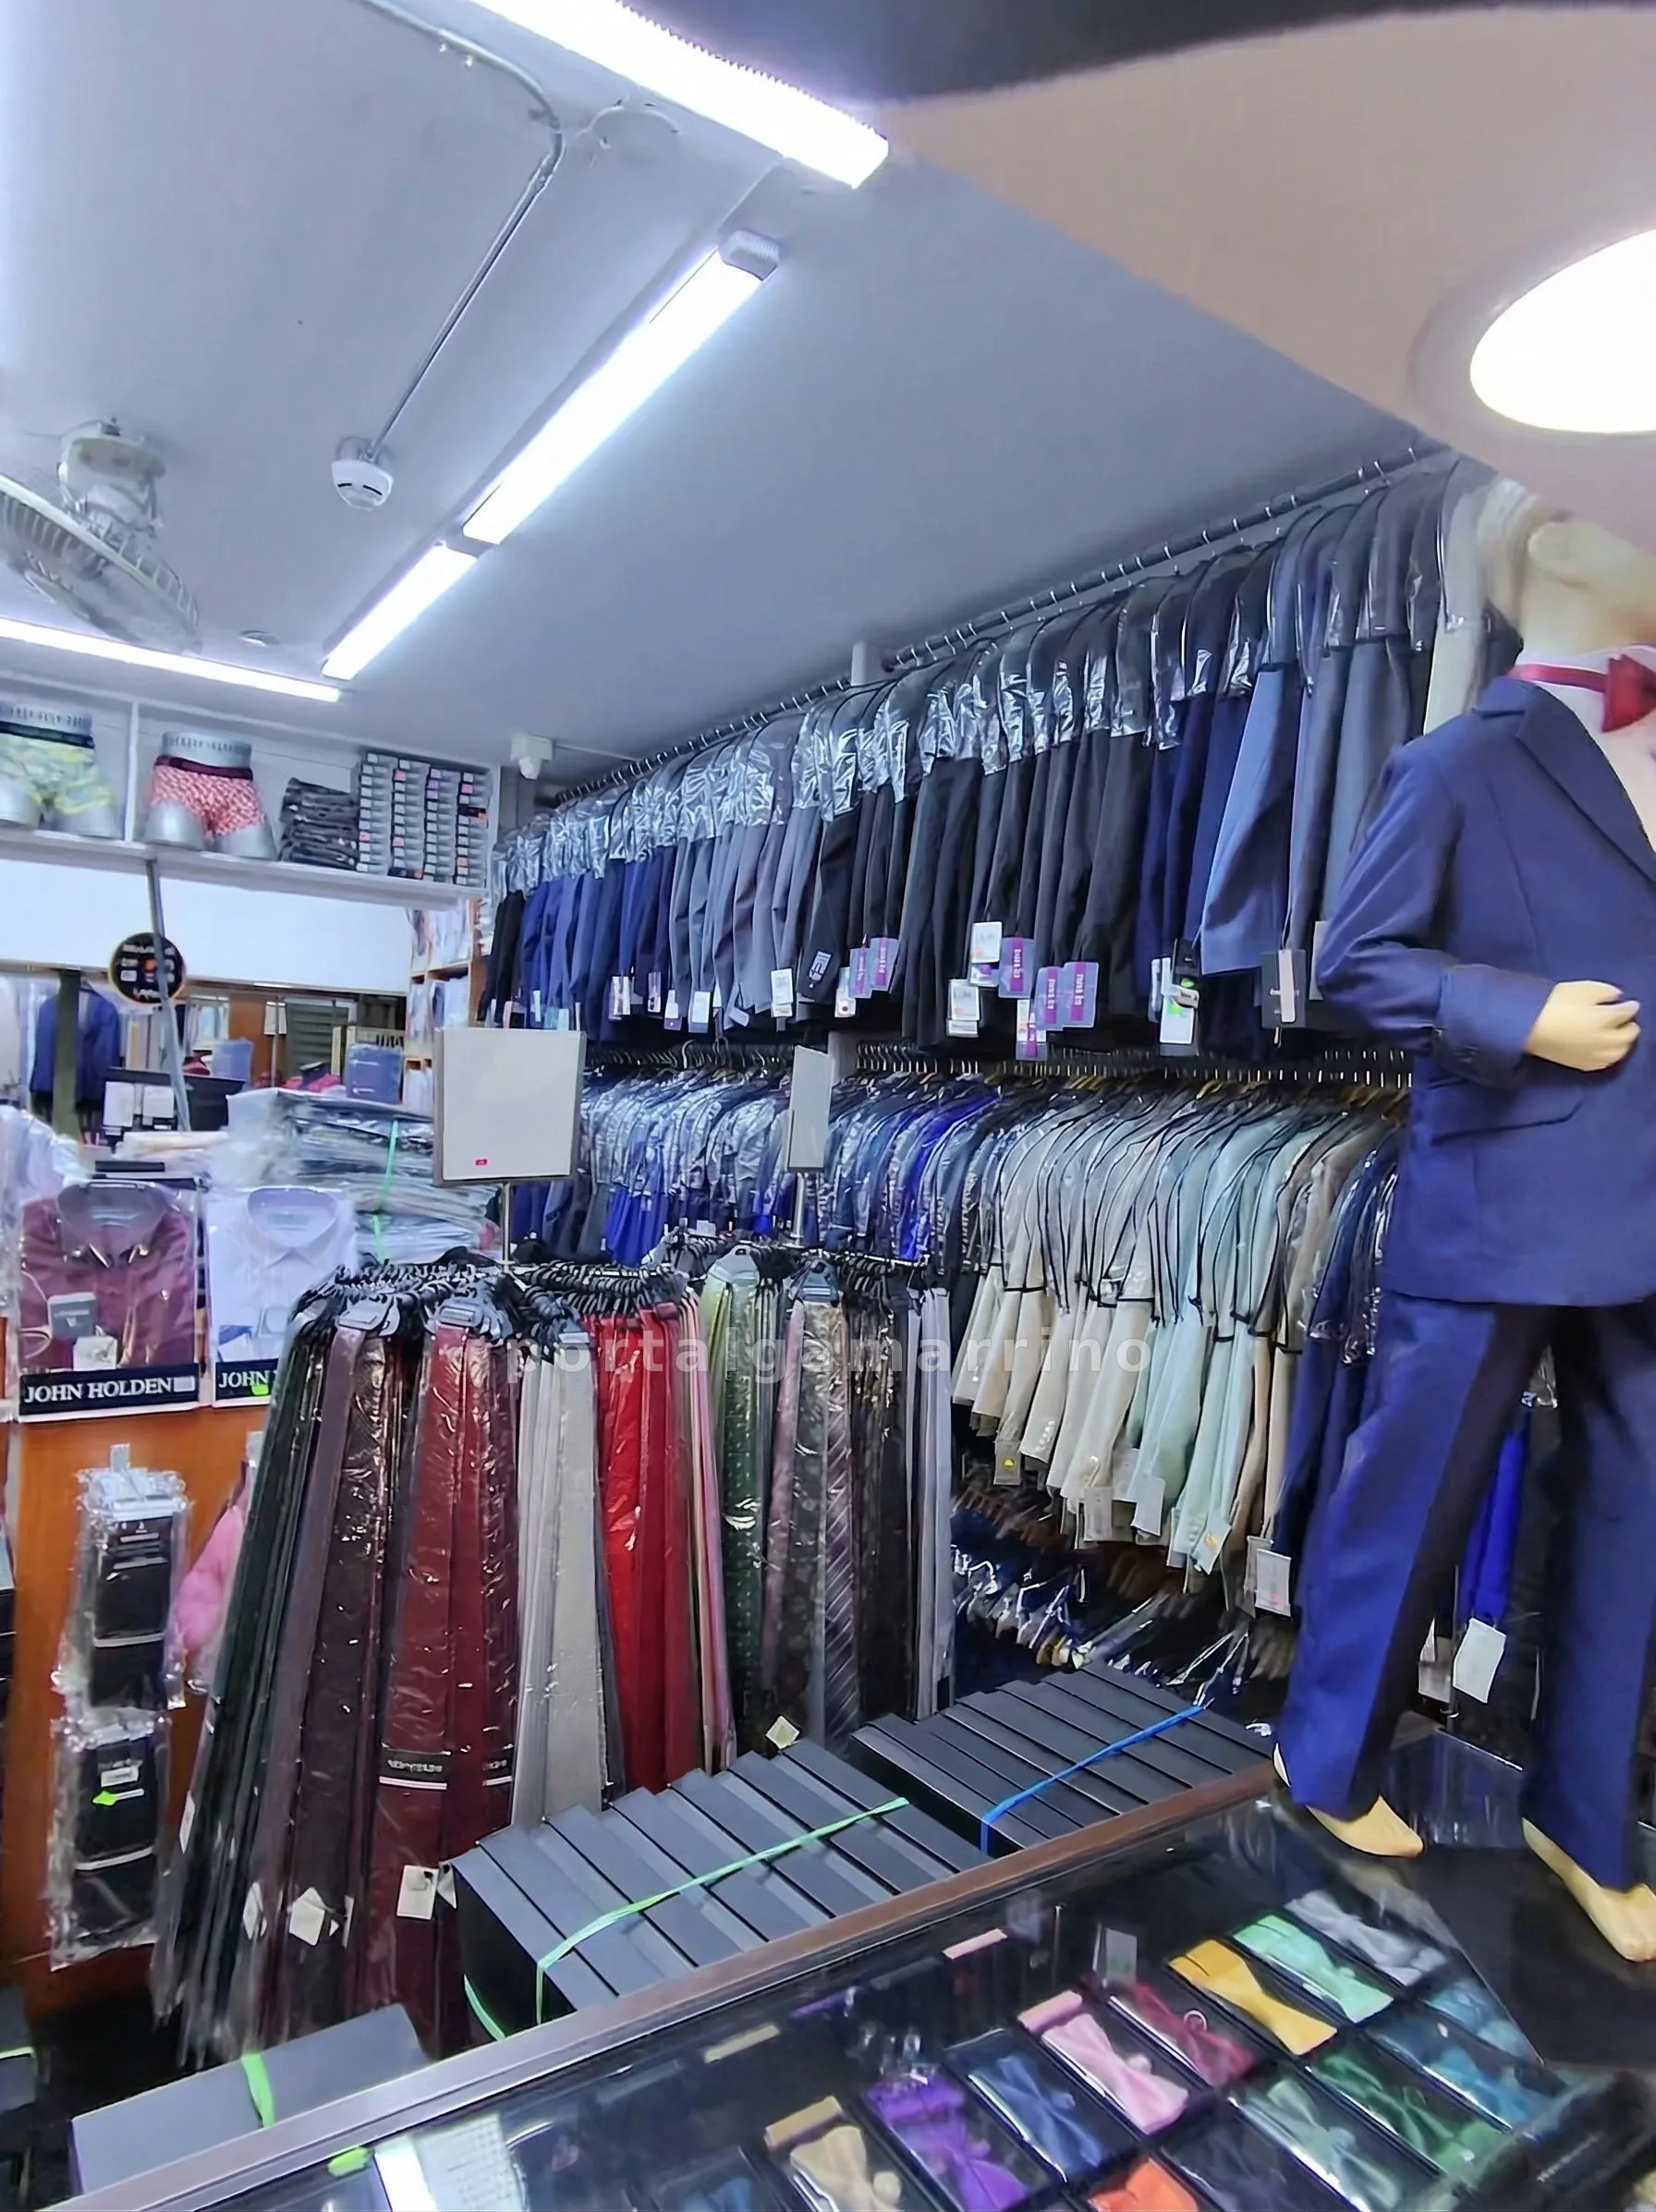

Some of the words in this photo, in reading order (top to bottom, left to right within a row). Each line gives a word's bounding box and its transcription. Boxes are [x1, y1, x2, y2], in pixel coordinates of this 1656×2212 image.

[24, 1383, 83, 1403] JOHN
[88, 1378, 174, 1399] HOLDEN
[218, 1370, 269, 1389] JOHN
